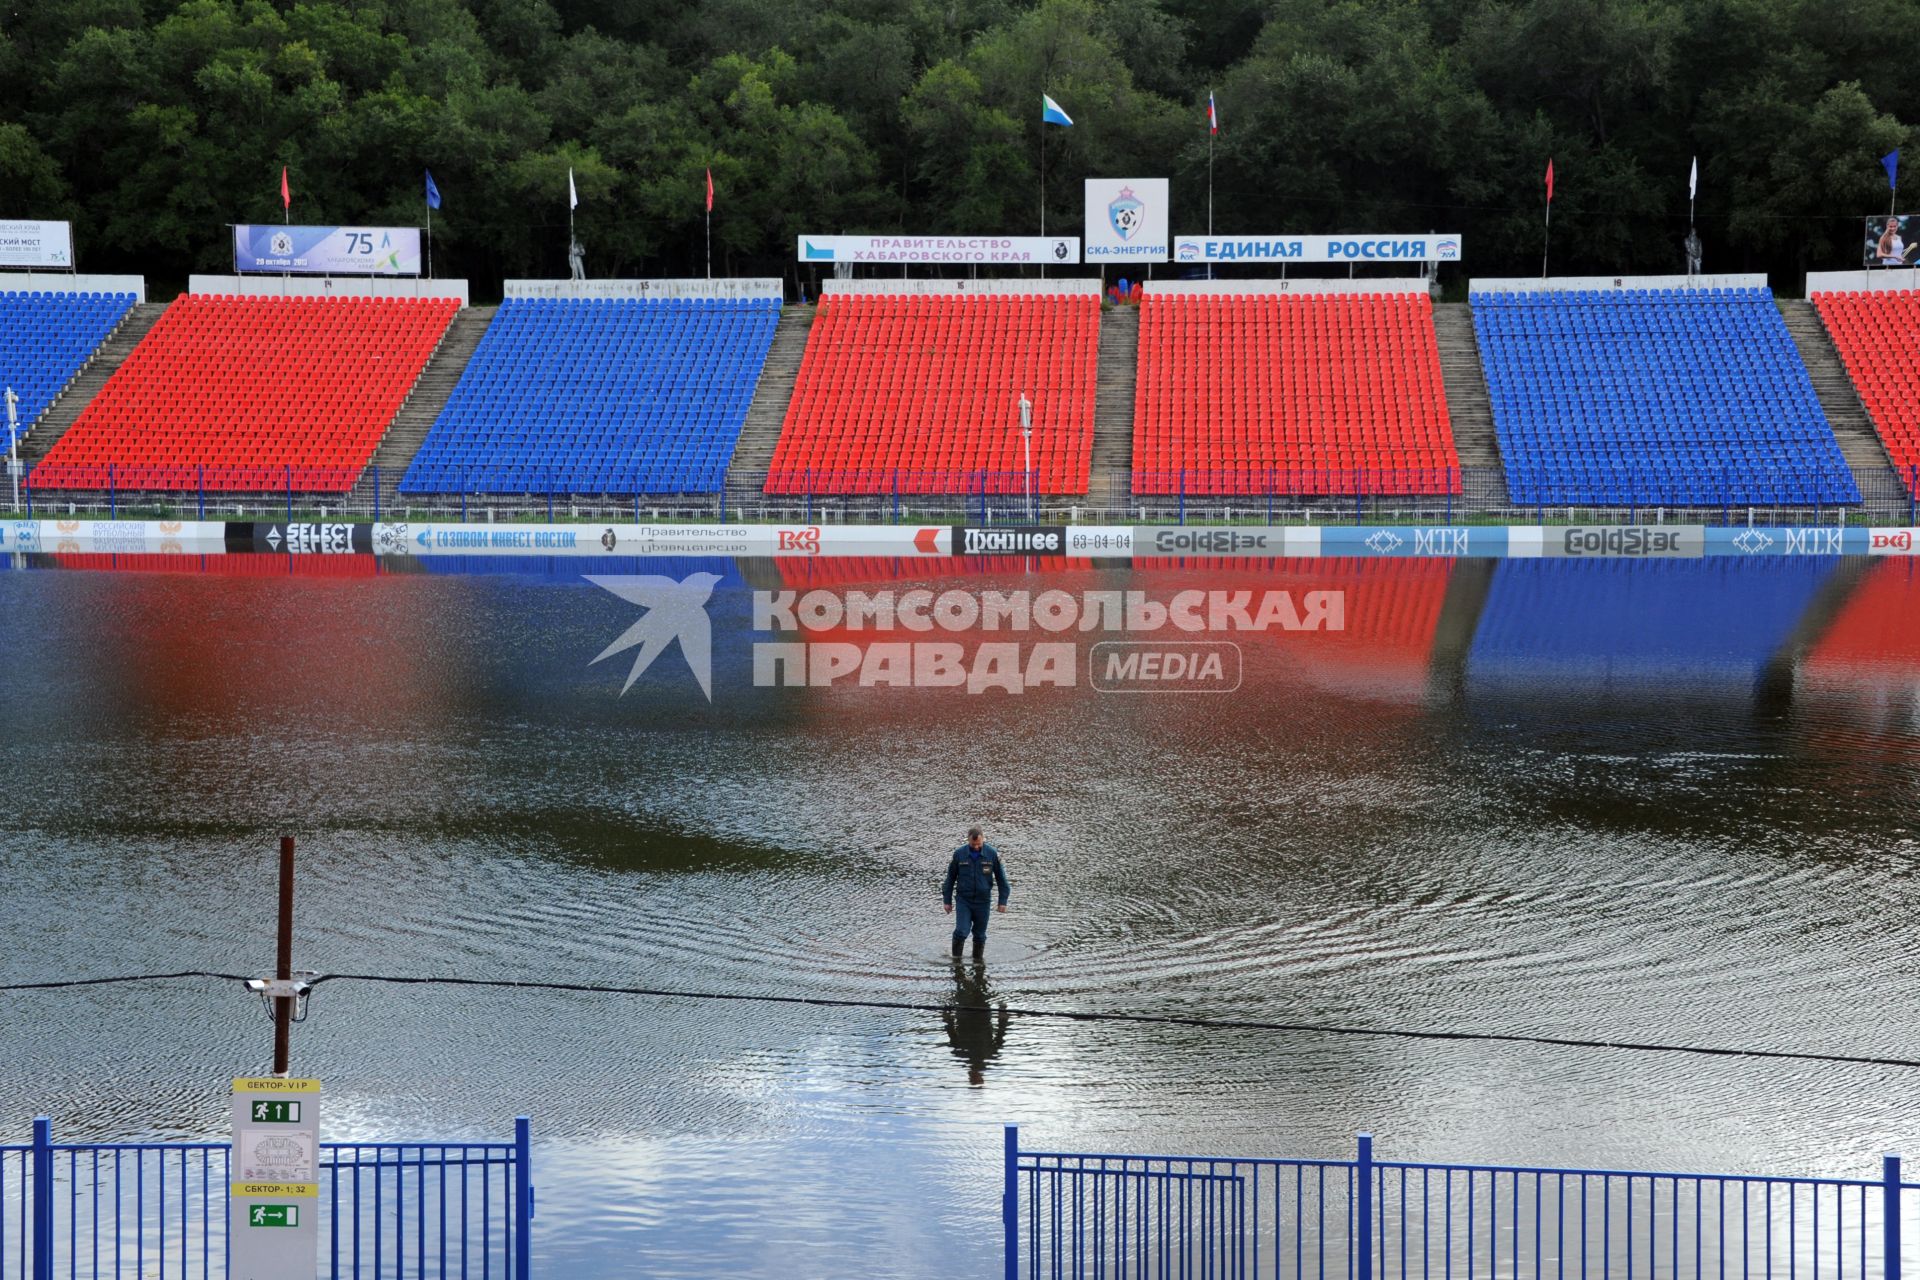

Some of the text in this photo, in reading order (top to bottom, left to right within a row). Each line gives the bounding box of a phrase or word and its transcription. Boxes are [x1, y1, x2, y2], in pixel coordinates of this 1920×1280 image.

[345, 233, 373, 254] 75
[870, 239, 1012, 249] ПРАВИТЕЛЬСТВО
[1087, 246, 1166, 255] СКА-ЭНЕРГИЯ
[1205, 241, 1426, 259] ЕДИНАЯ РОССИЯ
[854, 251, 1031, 261] ХАБАРОВСКОГО КРАЯ
[324, 280, 332, 288] 14
[640, 281, 650, 290] 15
[1281, 282, 1289, 290] 17
[93, 522, 146, 530] РОССИЙСКИЙ
[93, 529, 146, 537] ФУТБОЛЬНЫЙ
[286, 523, 355, 541] SELECT
[641, 527, 747, 537] Правительство
[295, 1185, 306, 1193] 32
